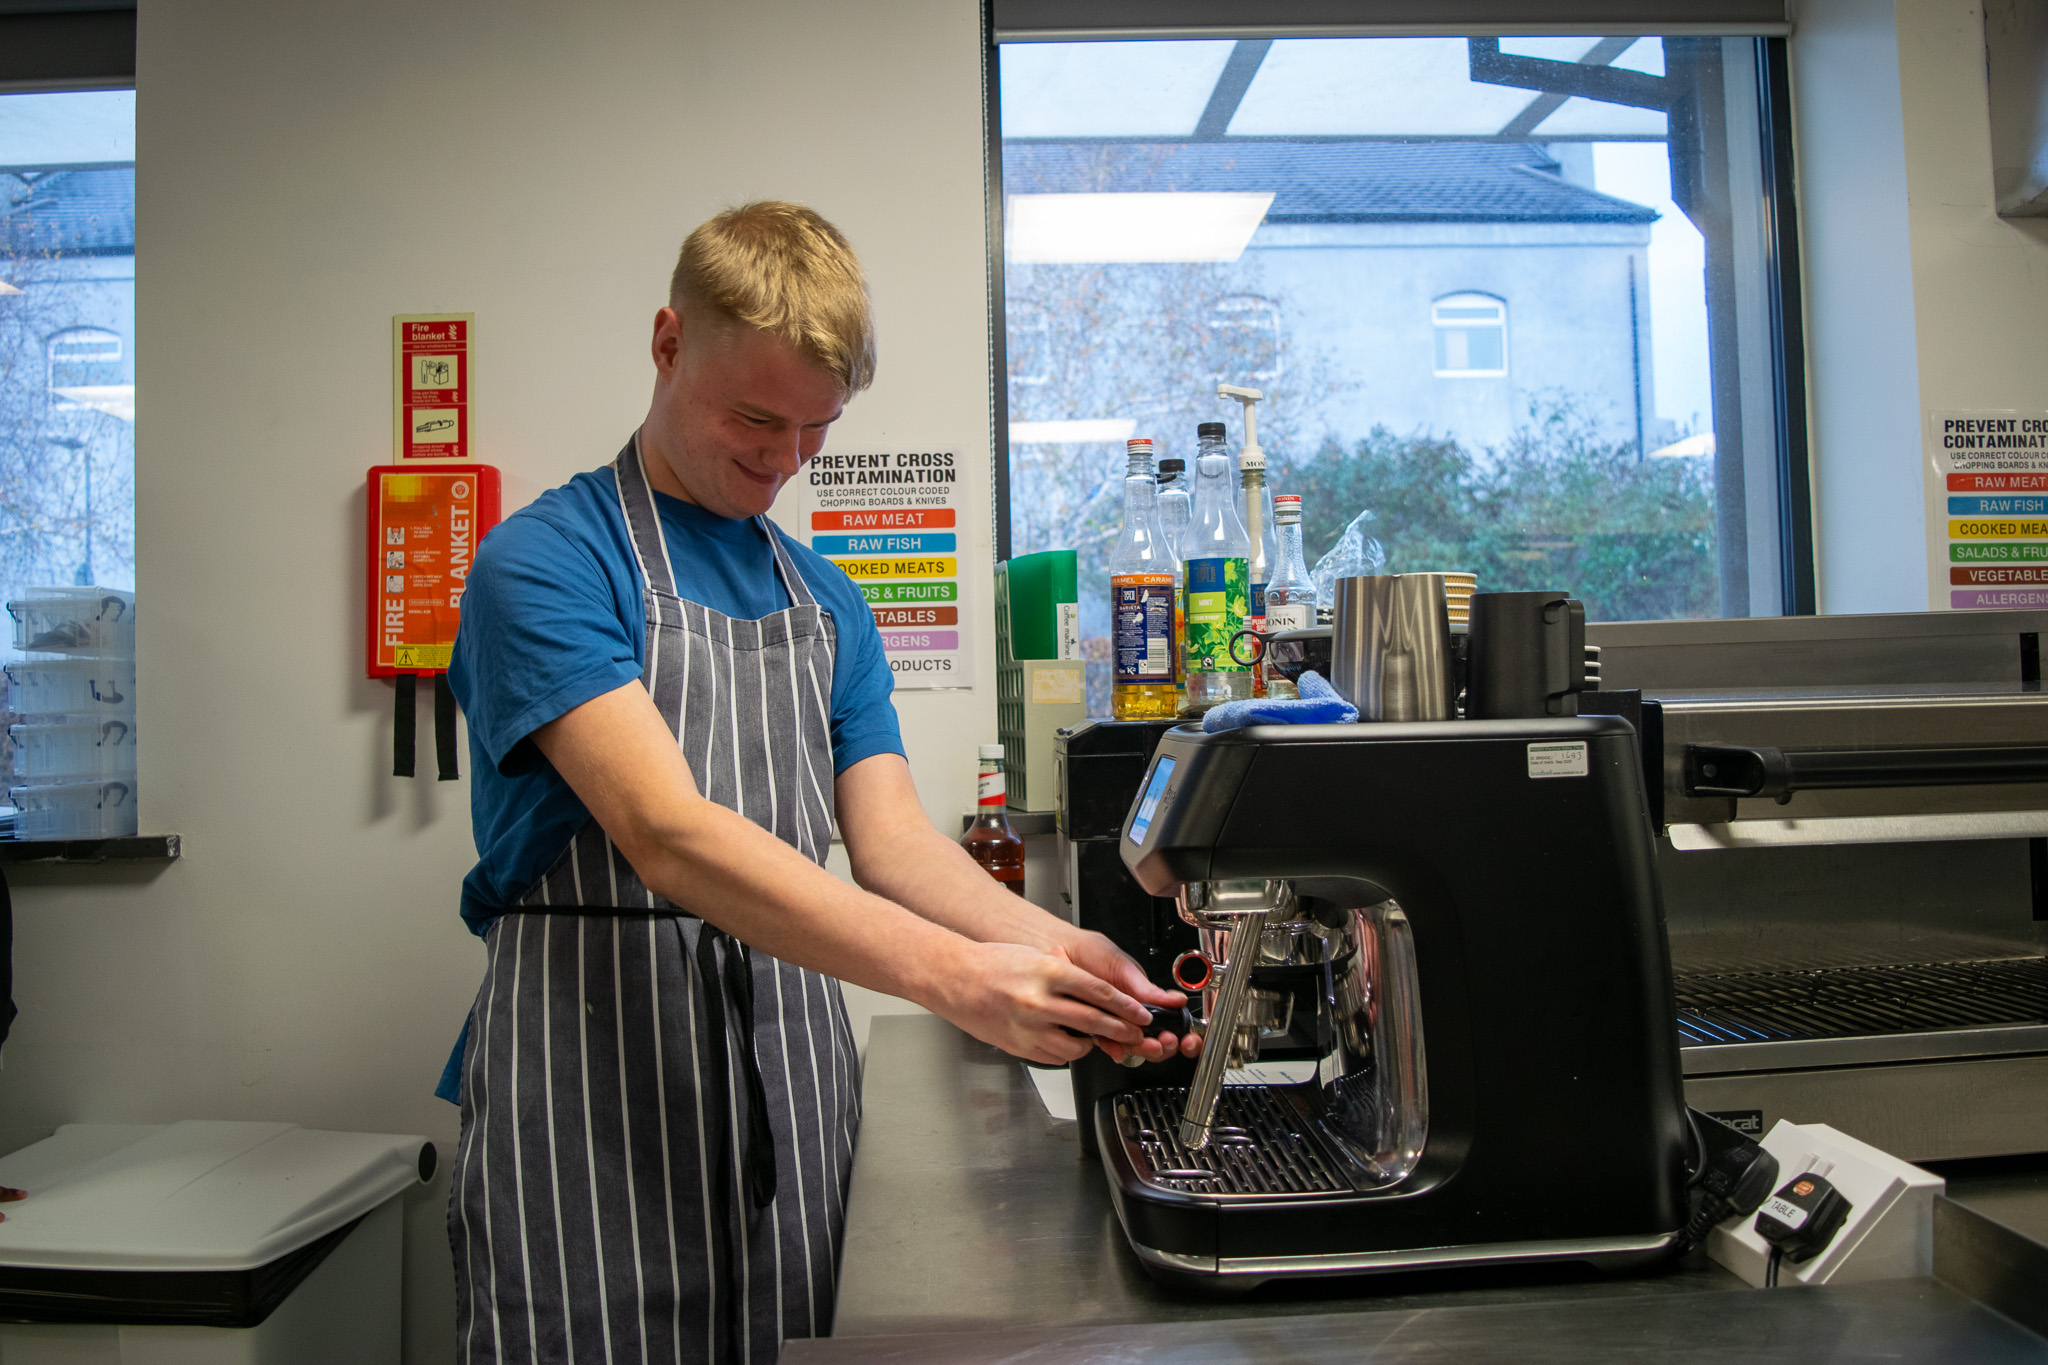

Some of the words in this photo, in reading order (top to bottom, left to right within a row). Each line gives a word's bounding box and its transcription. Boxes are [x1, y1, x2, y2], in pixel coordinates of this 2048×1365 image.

[412, 324, 430, 332] Fire
[412, 332, 445, 340] blanket
[1944, 420, 2016, 432] PREVENT
[2022, 420, 2048, 432] CRO
[1944, 434, 2048, 448] CONTAMINAT
[810, 454, 890, 469] PREVENT
[896, 453, 954, 467] CROSS
[810, 469, 956, 486] CONTAMINATION
[1974, 477, 2006, 488] RAW
[2010, 477, 2046, 488] MEAT
[836, 488, 878, 496] CORRECT
[880, 488, 917, 496] COLOUR
[919, 487, 950, 495] CODED
[820, 499, 866, 507] CHOPPING
[869, 498, 904, 506] BOARDS
[1980, 500, 2011, 511] RAW
[2015, 500, 2044, 511] FISH
[843, 514, 878, 526] RAW
[882, 513, 924, 525] MEAT
[1960, 523, 2016, 535] COOKED
[2021, 523, 2048, 534] MEA
[848, 538, 883, 551] RAW
[887, 538, 921, 550] FISH
[1956, 547, 2008, 558] SALADS
[2011, 547, 2019, 558] &
[2023, 547, 2048, 557] FRU
[838, 563, 890, 575] OOKED
[895, 561, 944, 574] MEATS
[1969, 570, 2048, 582] VEGETABLE
[884, 587, 893, 599] &
[898, 586, 950, 598] FRUITS
[1976, 593, 2048, 604] ALLERGEN
[385, 599, 404, 646] FIRE
[878, 610, 936, 623] TABLES
[882, 635, 930, 647] RGENS
[890, 659, 951, 671] ODUCTS
[1562, 752, 1582, 760] 1683
[1717, 1115, 1759, 1130] ncat
[1771, 1201, 1796, 1218] TABLE
